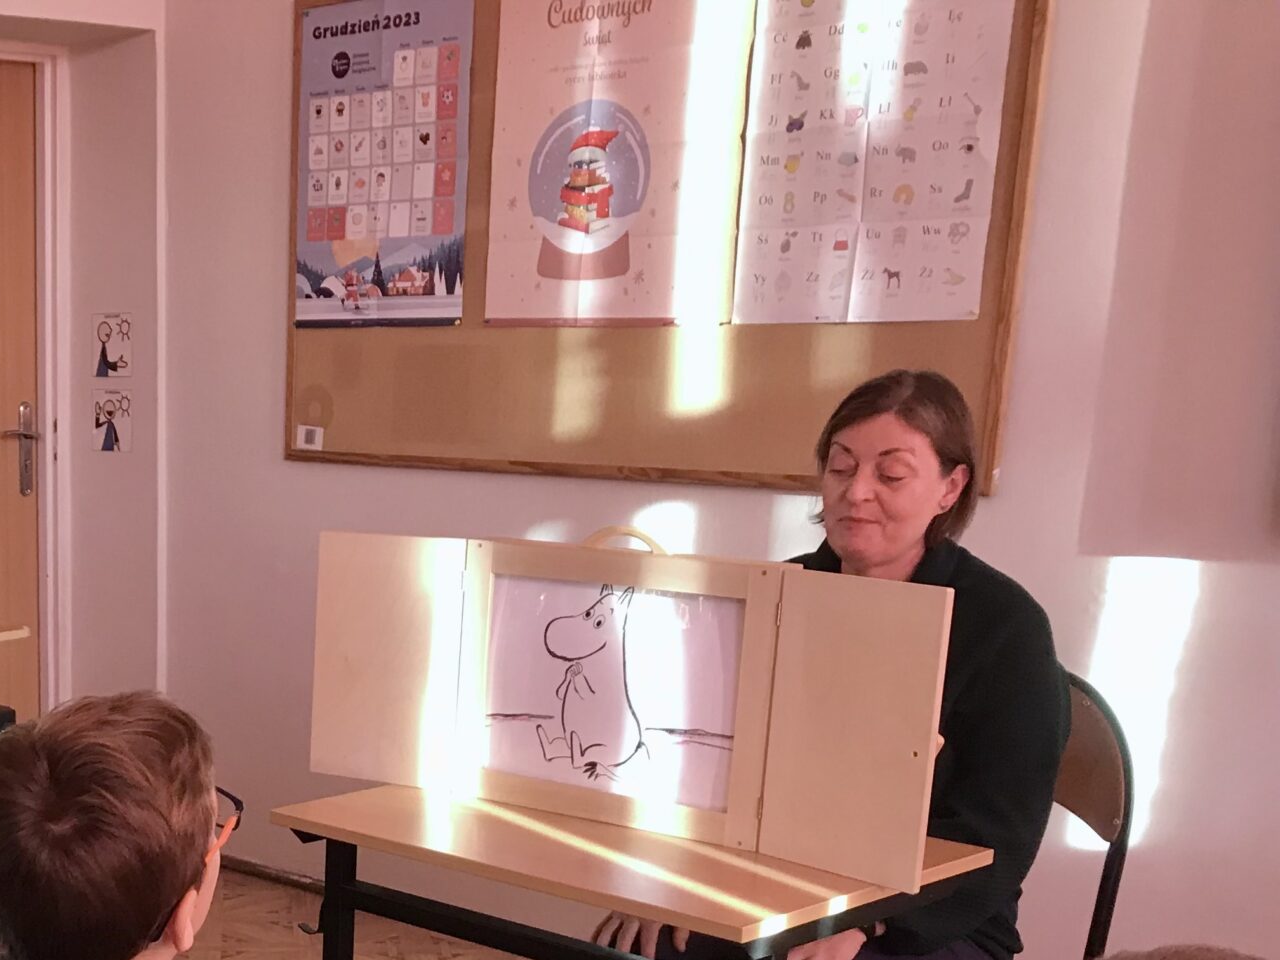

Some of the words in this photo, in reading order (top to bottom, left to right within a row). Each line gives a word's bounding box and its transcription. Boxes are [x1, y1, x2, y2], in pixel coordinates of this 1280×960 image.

[312, 14, 380, 40] Grudzień
[382, 11, 421, 30] 2023
[760, 154, 780, 166] Mm
[813, 191, 827, 204] Pp
